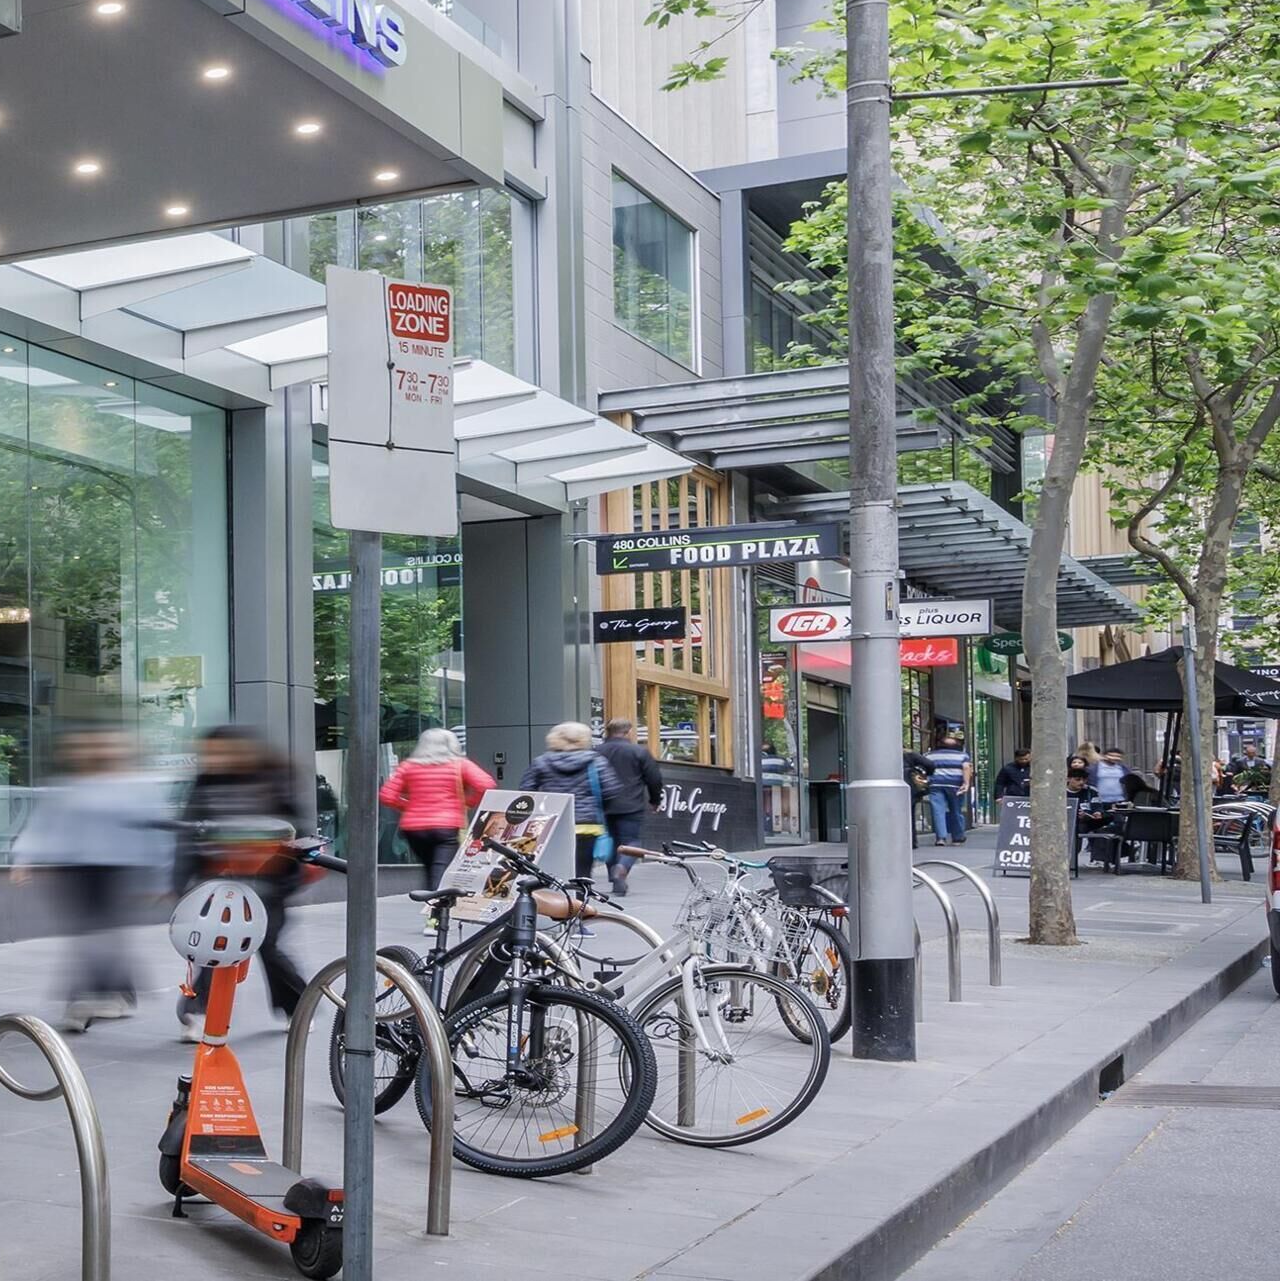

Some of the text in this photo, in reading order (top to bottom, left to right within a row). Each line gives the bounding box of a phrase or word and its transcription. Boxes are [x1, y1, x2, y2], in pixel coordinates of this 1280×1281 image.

[389, 289, 449, 316] LOADING
[394, 311, 446, 336] ZONE
[398, 341, 445, 359] 15 MINUTE
[405, 393, 422, 403] MON
[612, 534, 691, 551] 480 COLLINS
[669, 538, 821, 566] FOOD PLAZA
[916, 612, 982, 625] LIQUOR
[919, 607, 939, 615] plus
[454, 1005, 489, 1030] KENDA
